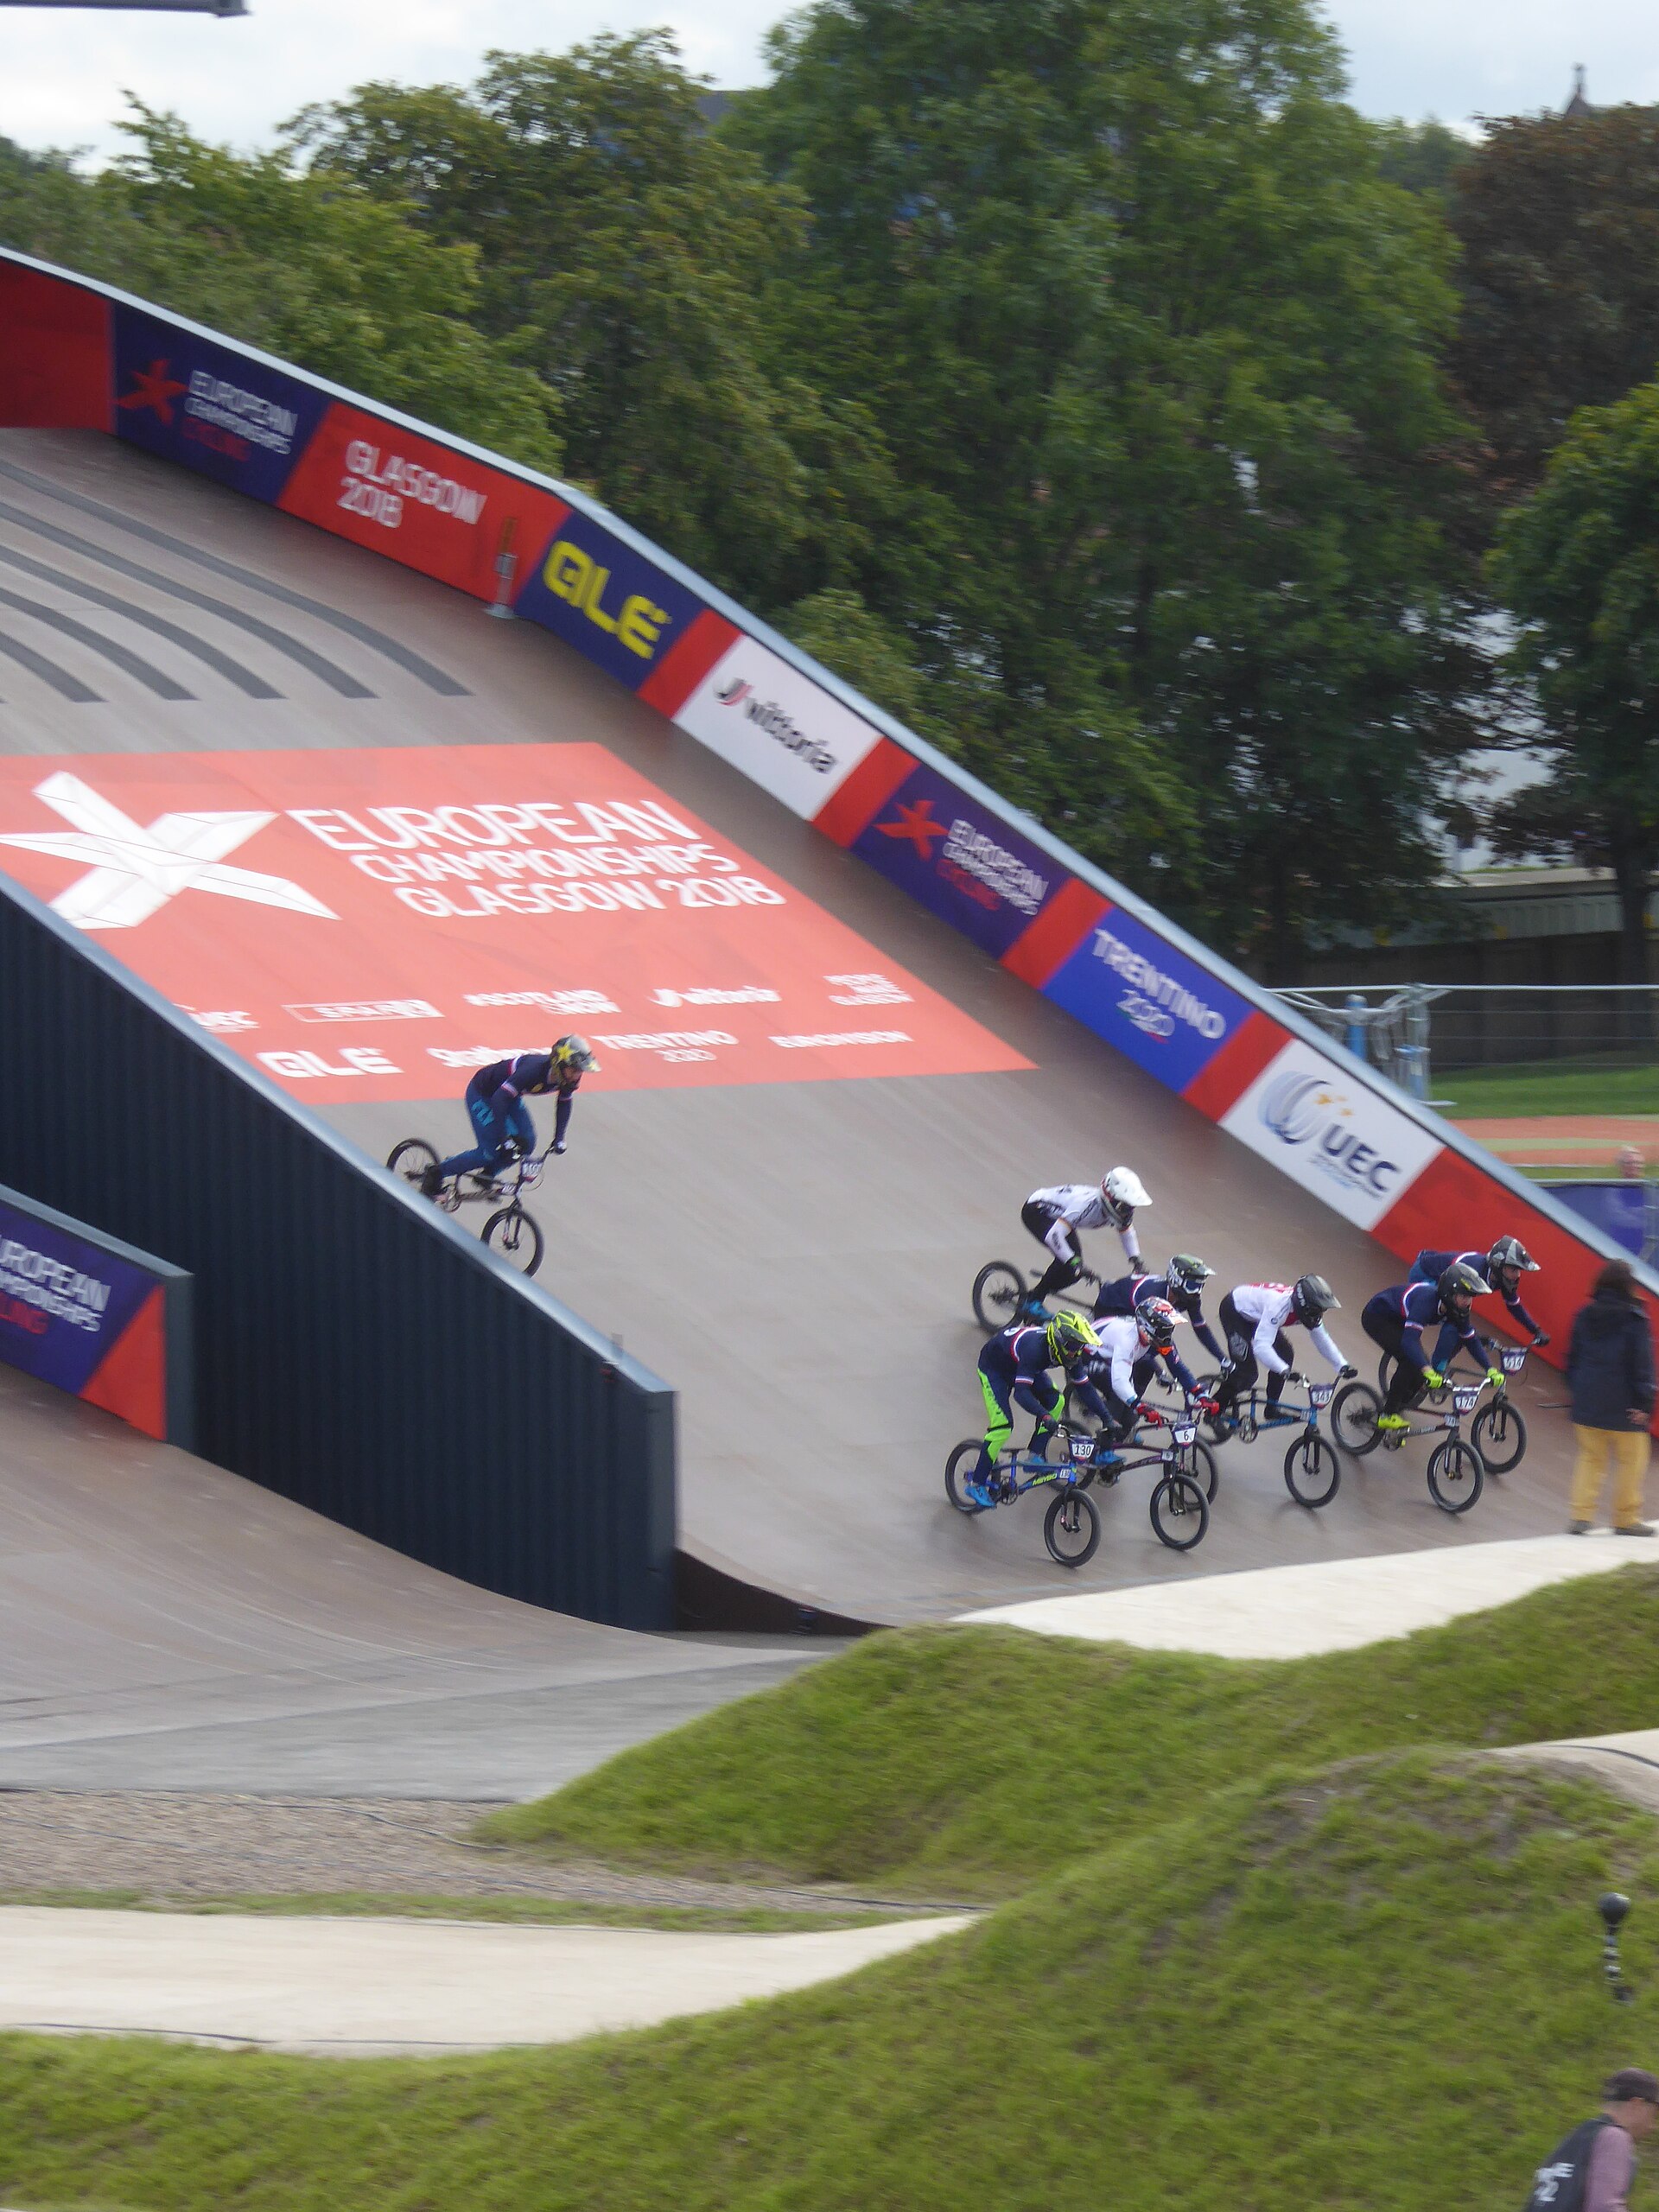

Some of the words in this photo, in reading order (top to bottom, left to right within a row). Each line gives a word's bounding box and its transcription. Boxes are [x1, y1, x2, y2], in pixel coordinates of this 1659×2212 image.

[188, 369, 298, 436] EUROPEAN
[337, 476, 404, 529] 2018
[345, 439, 487, 524] GLASGOW
[745, 696, 838, 774] vittoria
[285, 799, 702, 851] EUROPEAN
[349, 842, 741, 883] CHAMPIONSHIPS
[948, 818, 1049, 900] EUROPEAN
[393, 880, 667, 918] GLASGOW
[1092, 928, 1227, 1039] TRENTINO
[588, 1030, 740, 1050] TRENTINO
[1321, 1123, 1402, 1192] UEC
[1074, 1444, 1092, 1457] 130
[1183, 1430, 1190, 1441] 6
